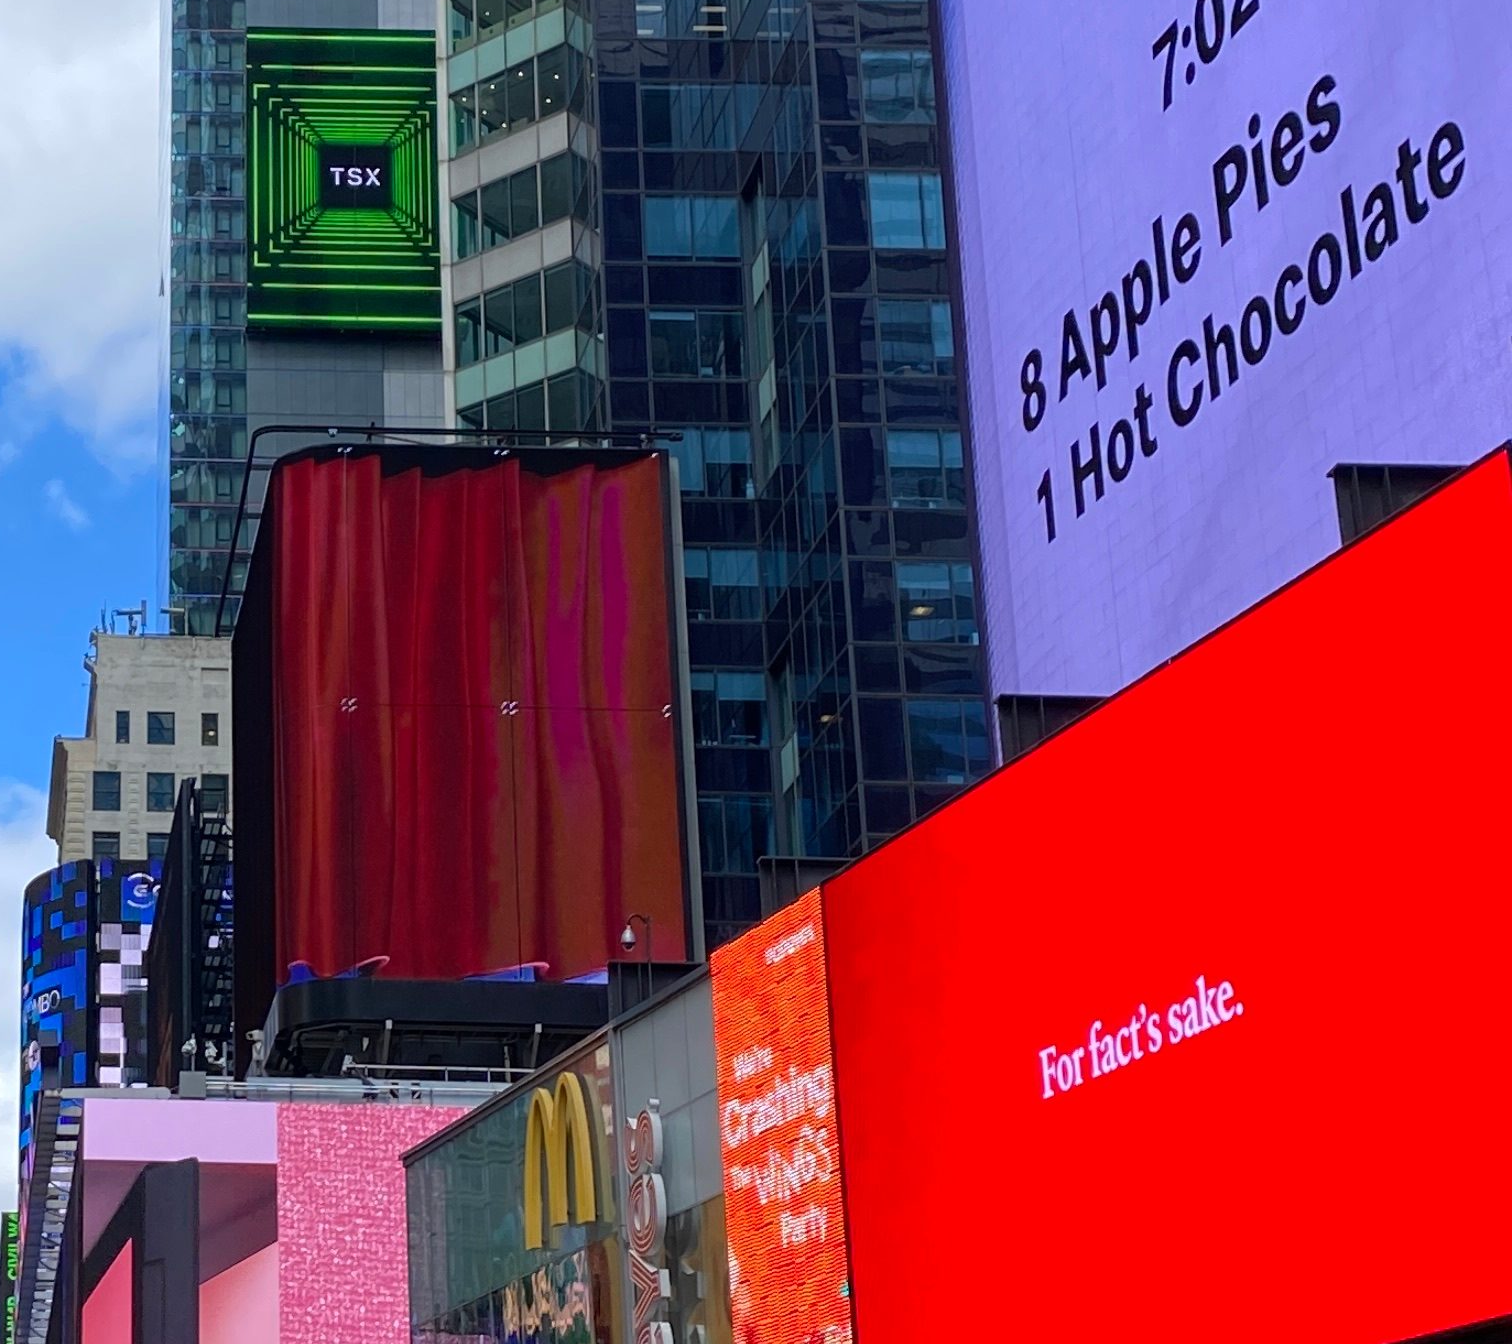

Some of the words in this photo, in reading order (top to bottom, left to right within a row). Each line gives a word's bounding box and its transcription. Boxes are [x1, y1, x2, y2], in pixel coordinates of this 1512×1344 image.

[329, 167, 381, 187] TSX
[1021, 348, 1044, 433] 8
[1058, 214, 1202, 403] Apple
[1213, 74, 1344, 223] Pies
[1037, 467, 1058, 543] 1
[1071, 410, 1160, 520] Hot
[1168, 121, 1469, 431] Chocolate
[1038, 1045, 1085, 1099] For
[1089, 1002, 1163, 1079] fact's
[1167, 974, 1244, 1045] sake.
